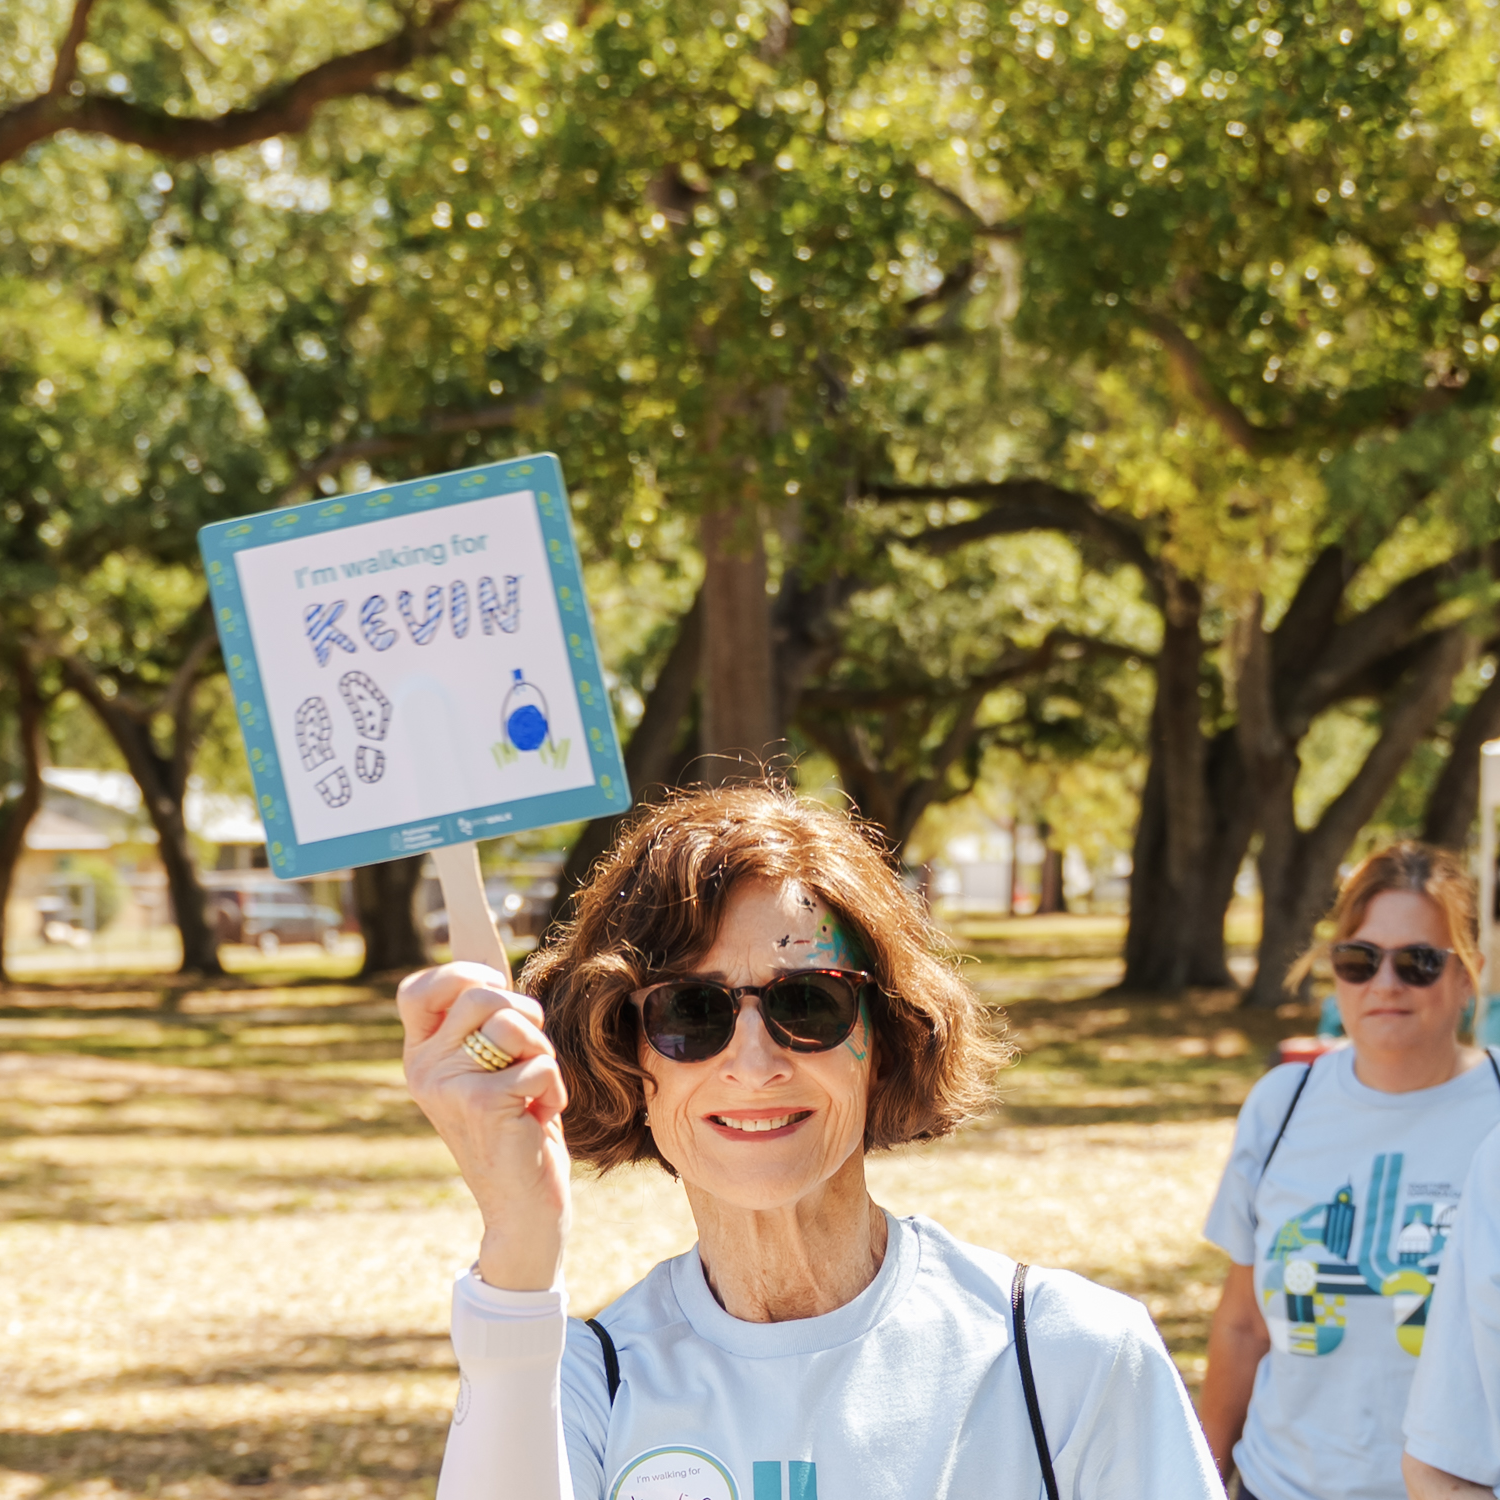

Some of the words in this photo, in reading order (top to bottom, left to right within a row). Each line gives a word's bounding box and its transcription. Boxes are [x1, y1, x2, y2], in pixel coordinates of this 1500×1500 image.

[294, 567, 338, 589] I'm
[340, 543, 449, 578] walking
[450, 534, 489, 556] for
[303, 574, 522, 668] KEVIN
[636, 1475, 650, 1484] I'm
[651, 1469, 687, 1481] walking
[688, 1467, 701, 1476] for
